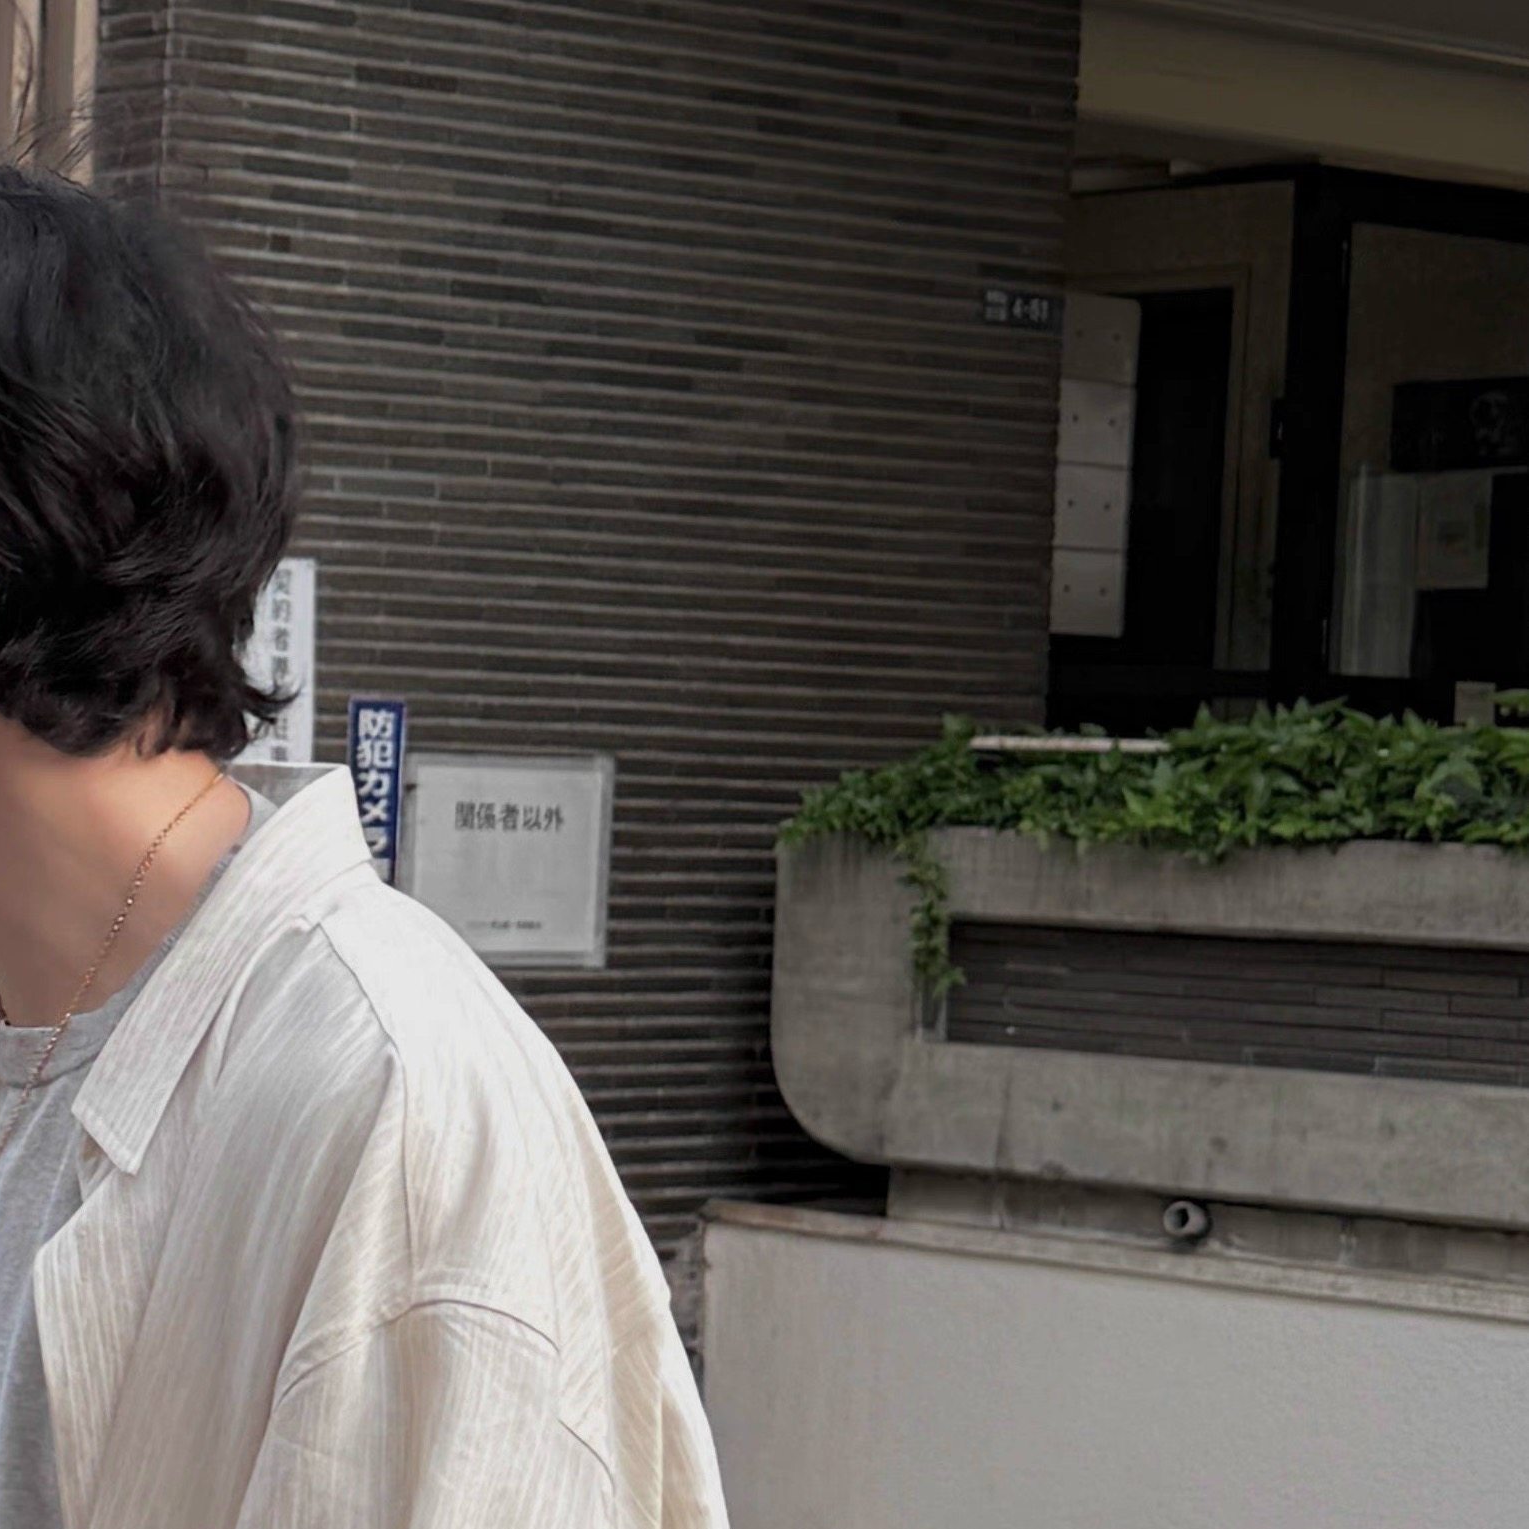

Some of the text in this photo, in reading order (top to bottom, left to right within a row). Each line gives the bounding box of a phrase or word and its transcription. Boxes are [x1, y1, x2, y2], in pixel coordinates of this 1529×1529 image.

[455, 801, 565, 833] 関係者以外
